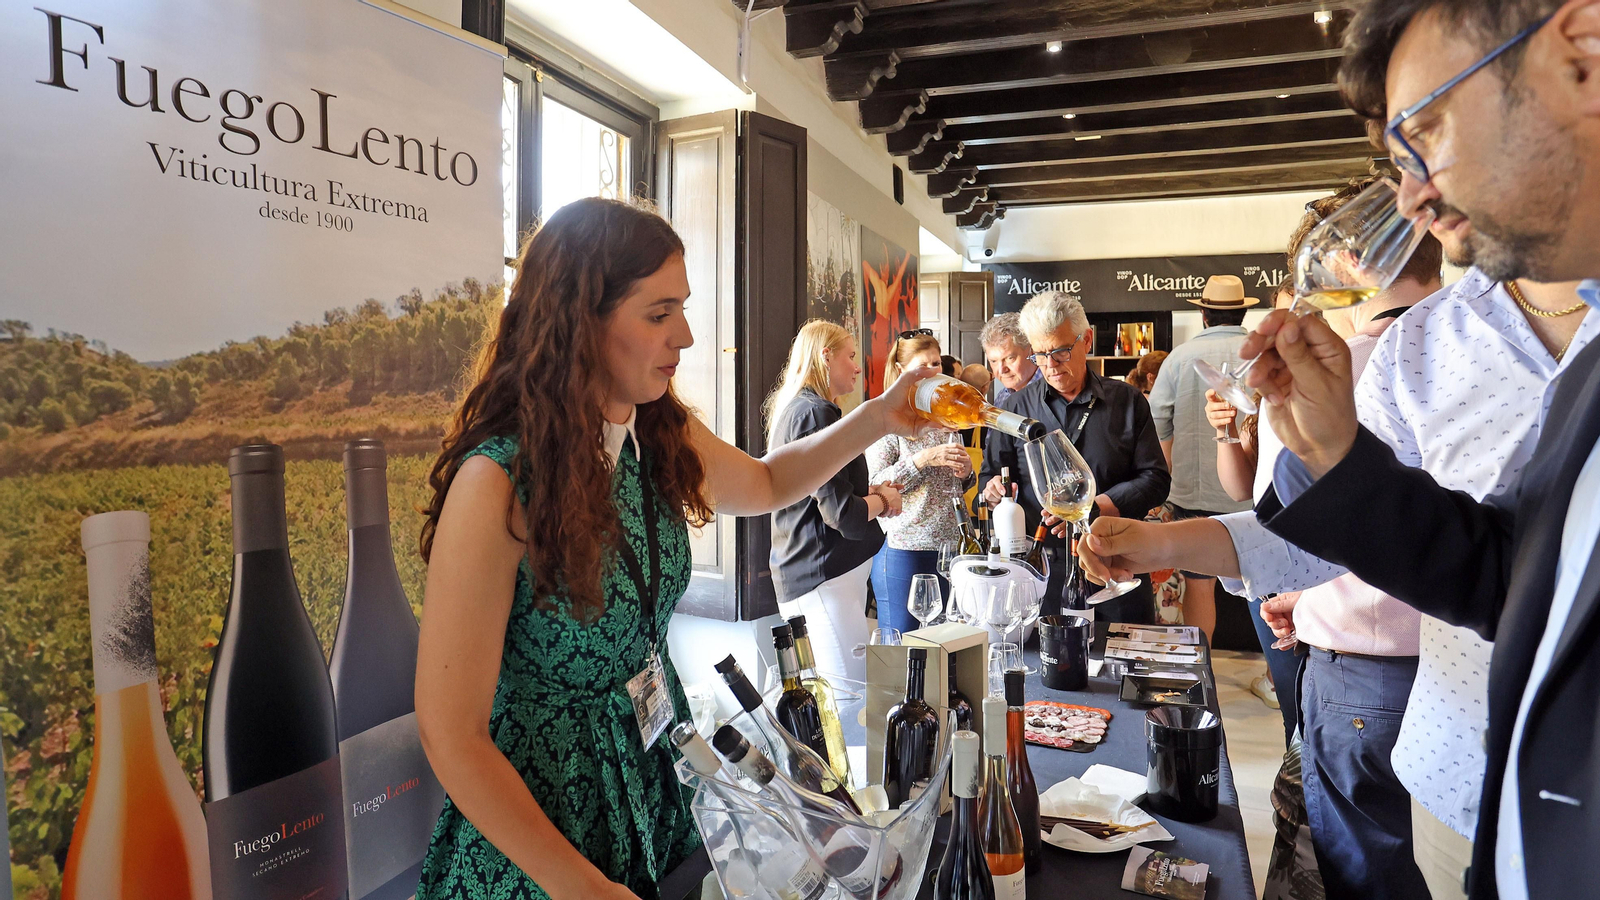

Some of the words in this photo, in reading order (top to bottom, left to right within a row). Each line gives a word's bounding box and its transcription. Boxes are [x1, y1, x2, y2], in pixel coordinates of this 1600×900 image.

[33, 6, 478, 187] FuegoLento
[146, 141, 318, 202] Viticultura
[327, 179, 430, 224] Extrema
[258, 201, 310, 225] desde
[316, 210, 354, 233] 1900
[1007, 277, 1081, 295] Alicante
[1127, 273, 1206, 292] Alicante
[352, 777, 419, 818] FuegoLento
[233, 812, 324, 860] FuegoLento
[252, 863, 278, 877] SECANO
[280, 848, 310, 865] EXTREMO
[260, 846, 302, 868] MONASTRELL
